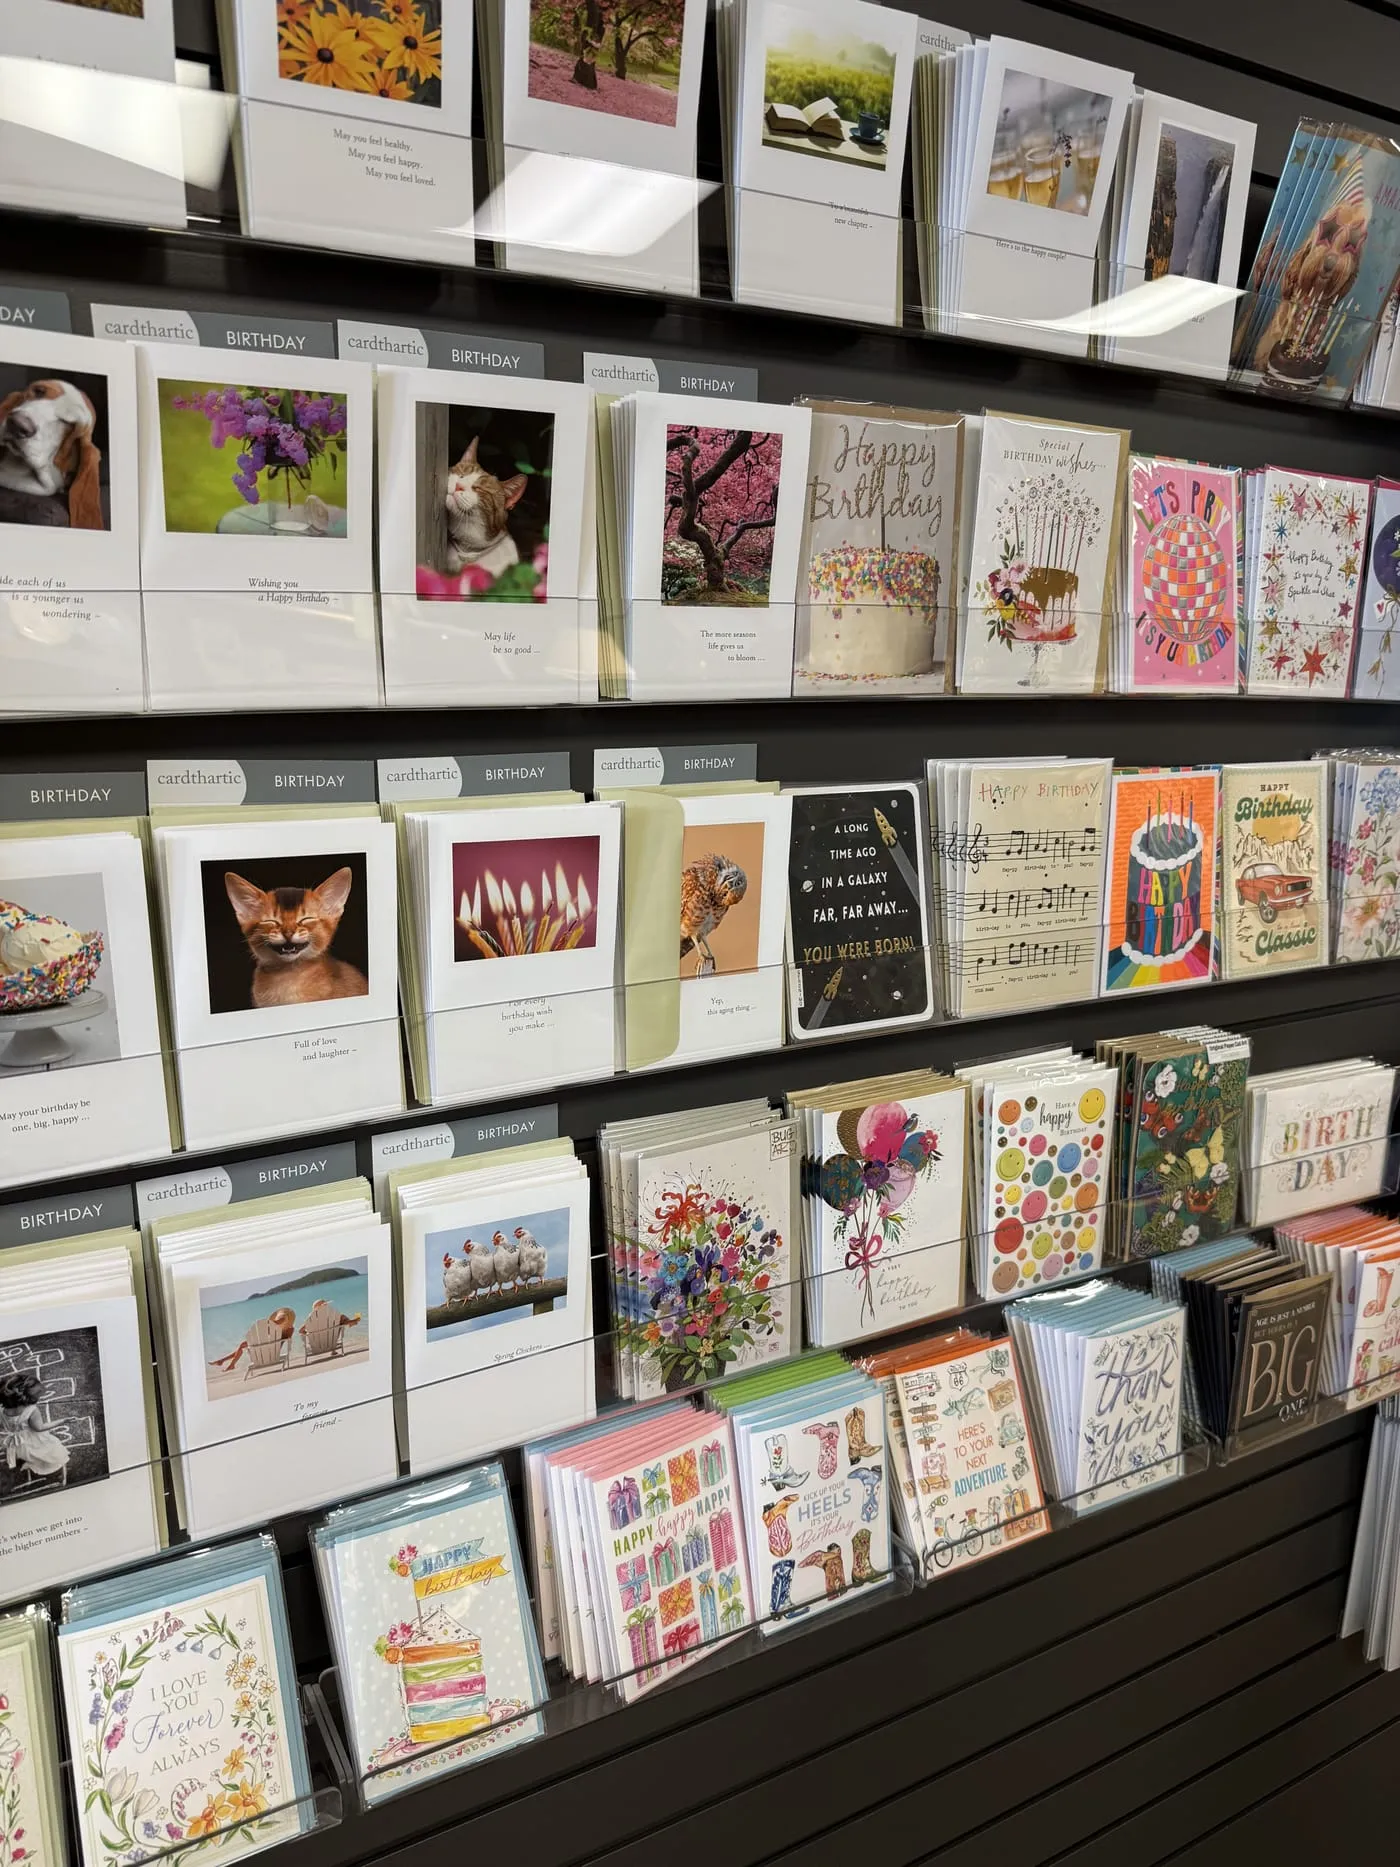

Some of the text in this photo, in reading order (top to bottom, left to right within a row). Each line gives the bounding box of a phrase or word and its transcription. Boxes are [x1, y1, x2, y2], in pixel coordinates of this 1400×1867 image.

[333, 128, 413, 152] May you feel healthy.
[348, 148, 424, 170] May you feel happy.
[366, 166, 436, 187] May you feel loved.
[104, 318, 306, 351] cardthartic BIRTHDAY
[347, 333, 520, 370] cardthartic BIRTHDAY
[591, 364, 736, 393] cardthartic BIRTHDAY
[834, 422, 937, 488] Happy
[1039, 439, 1070, 452] Special
[1003, 450, 1054, 465] BIRTHDAY
[808, 472, 943, 538] Birthday
[1191, 480, 1231, 537] PARTY
[16, 577, 67, 590] each of us
[248, 578, 299, 592] Wishing you
[32, 593, 85, 607] younger us
[296, 592, 331, 606] Birthday
[42, 607, 92, 622] wondering
[484, 632, 516, 643] May life
[700, 630, 714, 639] The
[733, 631, 757, 639] seasons
[492, 644, 532, 656] be so good
[708, 642, 719, 650] life
[720, 642, 734, 652] gives
[728, 654, 756, 662] to bloom
[386, 767, 546, 783] cardthartic BIRTHDAY
[601, 757, 736, 771] cardthartic BIRTHDAY
[158, 770, 345, 788] cardthartic BIRTHDAY
[1260, 784, 1290, 792] HAPPY
[30, 788, 112, 804] BIRTHDAY
[979, 782, 1100, 802] HAPPY BIRTHDAY
[1234, 794, 1314, 822] Birthday
[834, 824, 869, 834] A LONG
[830, 847, 876, 860] TIME AGO
[822, 872, 888, 889] IN A GALAXY
[1137, 861, 1193, 907] HAPPY
[813, 900, 908, 924] FAR, FAR AWAY...
[804, 936, 915, 965] YOU WERE BORN!
[1255, 922, 1318, 957] Classic
[502, 1009, 534, 1021] birthday
[508, 1020, 544, 1036] you make
[294, 1038, 338, 1049] Full of love
[302, 1048, 350, 1061] and laughter
[18, 1108, 40, 1120] your
[40, 1102, 78, 1114] birthday
[80, 1100, 90, 1108] be
[1040, 1102, 1072, 1132] happy
[12, 1124, 32, 1132] one,
[52, 1114, 79, 1126] happy
[382, 1120, 536, 1155] cardthartic BIRTHDAY
[772, 1128, 794, 1144] BUG
[146, 1160, 328, 1202] cardthartic BIRTHDAY
[1293, 1151, 1354, 1192] DAY
[20, 1204, 104, 1230] BIRTHDAY
[1095, 1342, 1174, 1417] thank
[1242, 1325, 1317, 1417] BIG
[310, 1416, 337, 1434] friend
[957, 1422, 986, 1441] HERE'S
[954, 1435, 995, 1460] TO YOUR
[1093, 1404, 1168, 1485] you
[966, 1453, 988, 1472] NEXT
[804, 1480, 846, 1502] KICK UP YOUR
[954, 1462, 1009, 1498] ADVENTURE
[798, 1488, 853, 1522] HEELS
[613, 1485, 732, 1557] HAPPY happy HAPPY
[821, 1510, 839, 1524] YOUR
[10, 1516, 83, 1541] when we get into
[796, 1516, 856, 1553] Birthday
[0, 1528, 81, 1556] the higher numbers
[420, 1544, 472, 1574] HAPPY
[424, 1567, 498, 1596] birthday
[150, 1670, 208, 1702] I LOVE
[162, 1691, 199, 1714] YOU
[132, 1698, 224, 1754] Forever
[178, 1735, 189, 1748] &
[150, 1738, 220, 1776] ALWAYS
